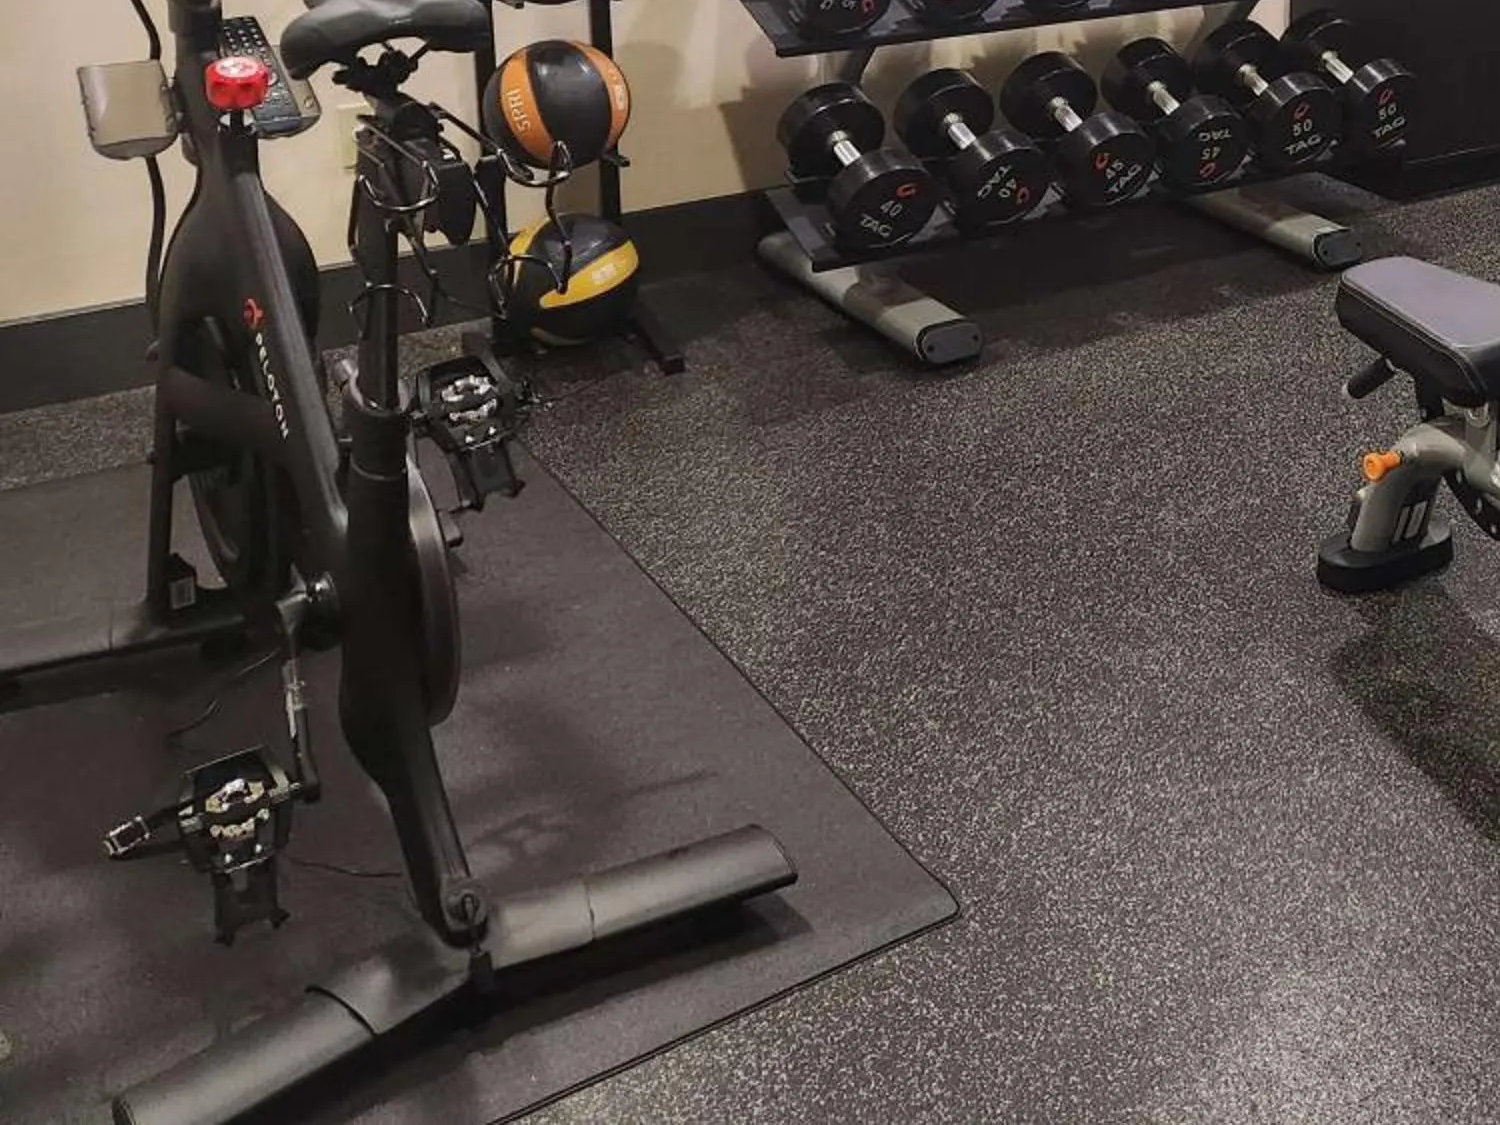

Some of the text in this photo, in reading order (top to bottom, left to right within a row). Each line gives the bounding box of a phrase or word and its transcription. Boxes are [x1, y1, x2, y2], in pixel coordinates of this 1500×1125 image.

[505, 88, 531, 132] SPRI
[880, 200, 903, 217] 40
[253, 331, 290, 443] PELOTON
